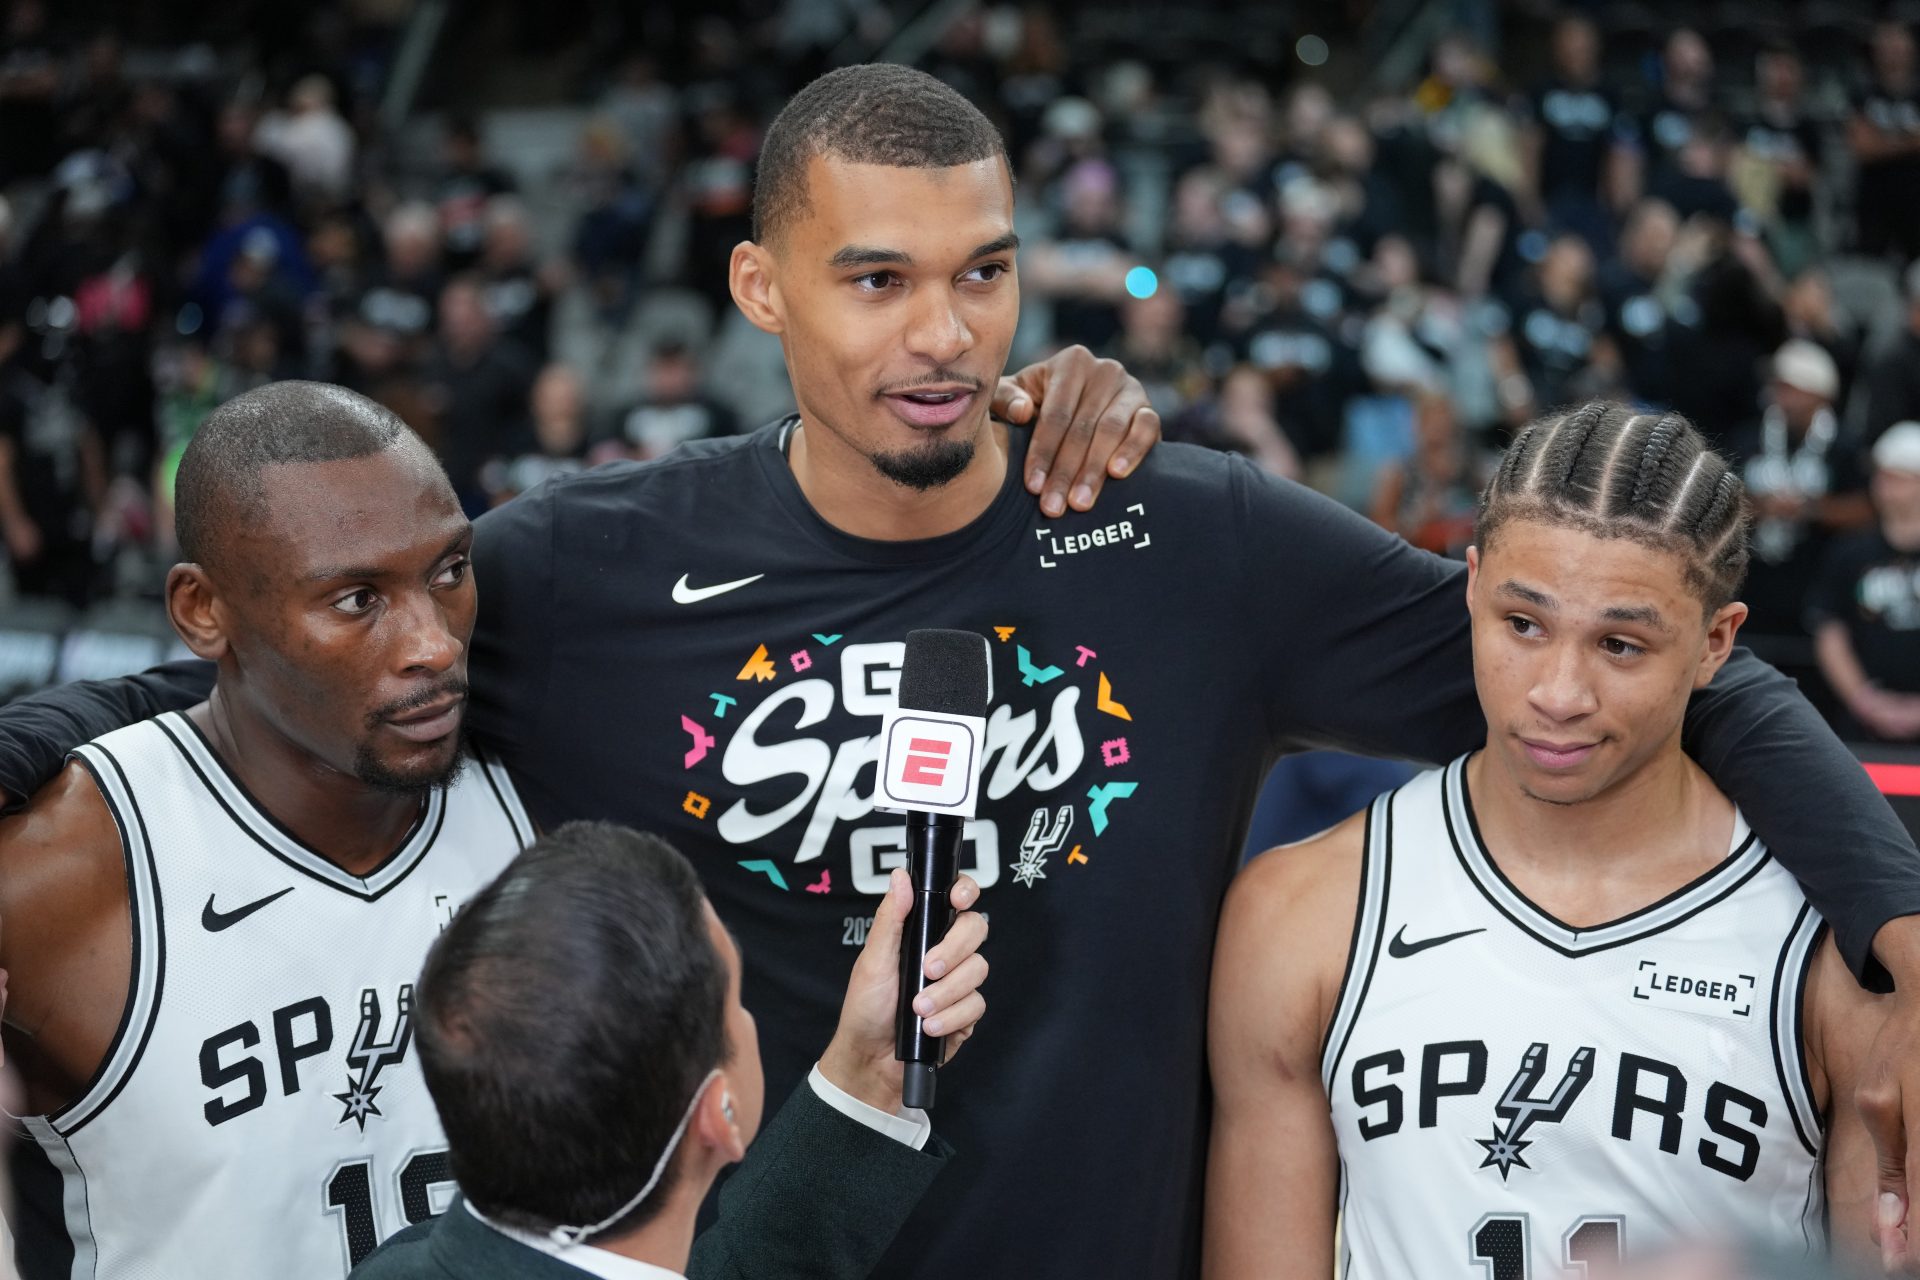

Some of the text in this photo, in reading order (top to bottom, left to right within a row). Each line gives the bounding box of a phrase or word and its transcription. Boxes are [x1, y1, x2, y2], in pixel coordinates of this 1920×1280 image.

[1051, 521, 1134, 555] LEDGER
[841, 641, 994, 716] G
[718, 679, 1084, 863] Sprs
[1650, 973, 1737, 1002] LEDGER
[199, 984, 416, 1133] SPU
[1352, 1040, 1768, 1181] SPURS
